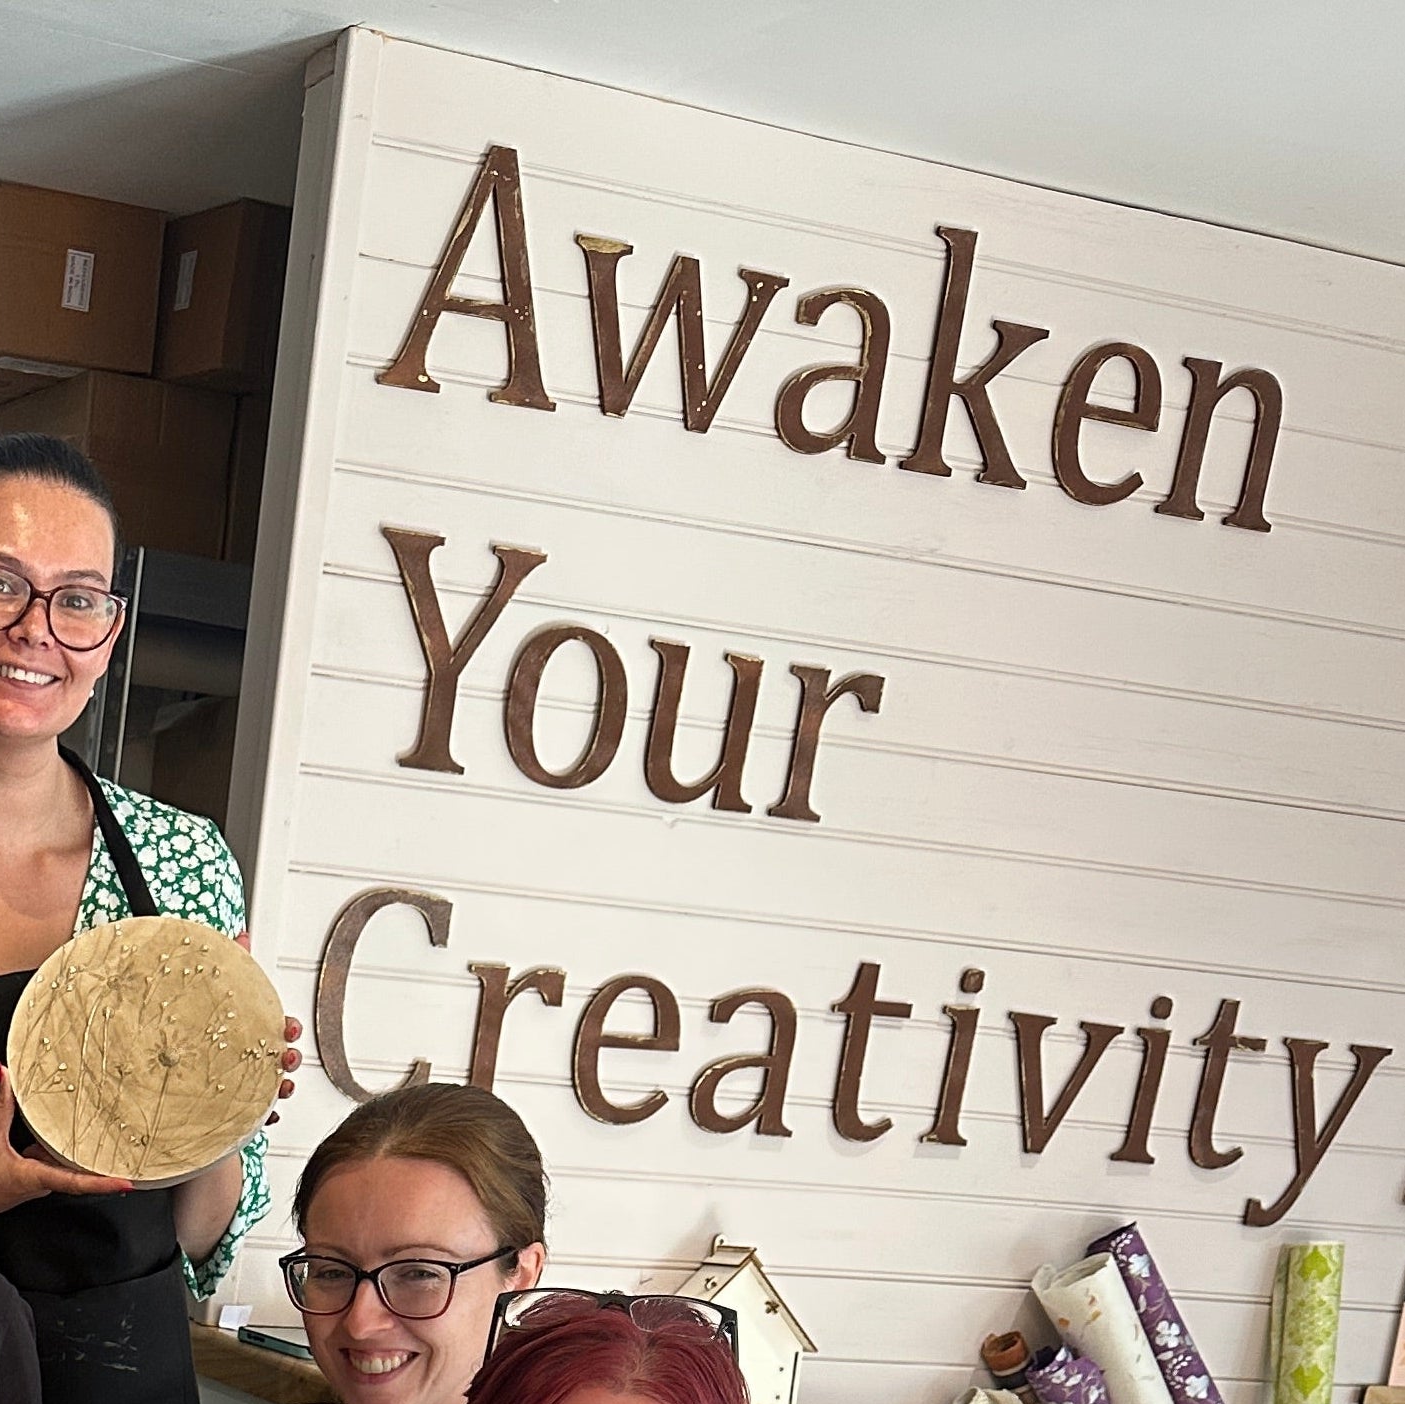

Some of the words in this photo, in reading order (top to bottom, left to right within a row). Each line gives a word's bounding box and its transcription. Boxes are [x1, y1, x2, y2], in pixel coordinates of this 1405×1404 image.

[375, 145, 1285, 533] Awaken
[381, 522, 886, 823] Your
[316, 888, 1393, 1228] Creativity
